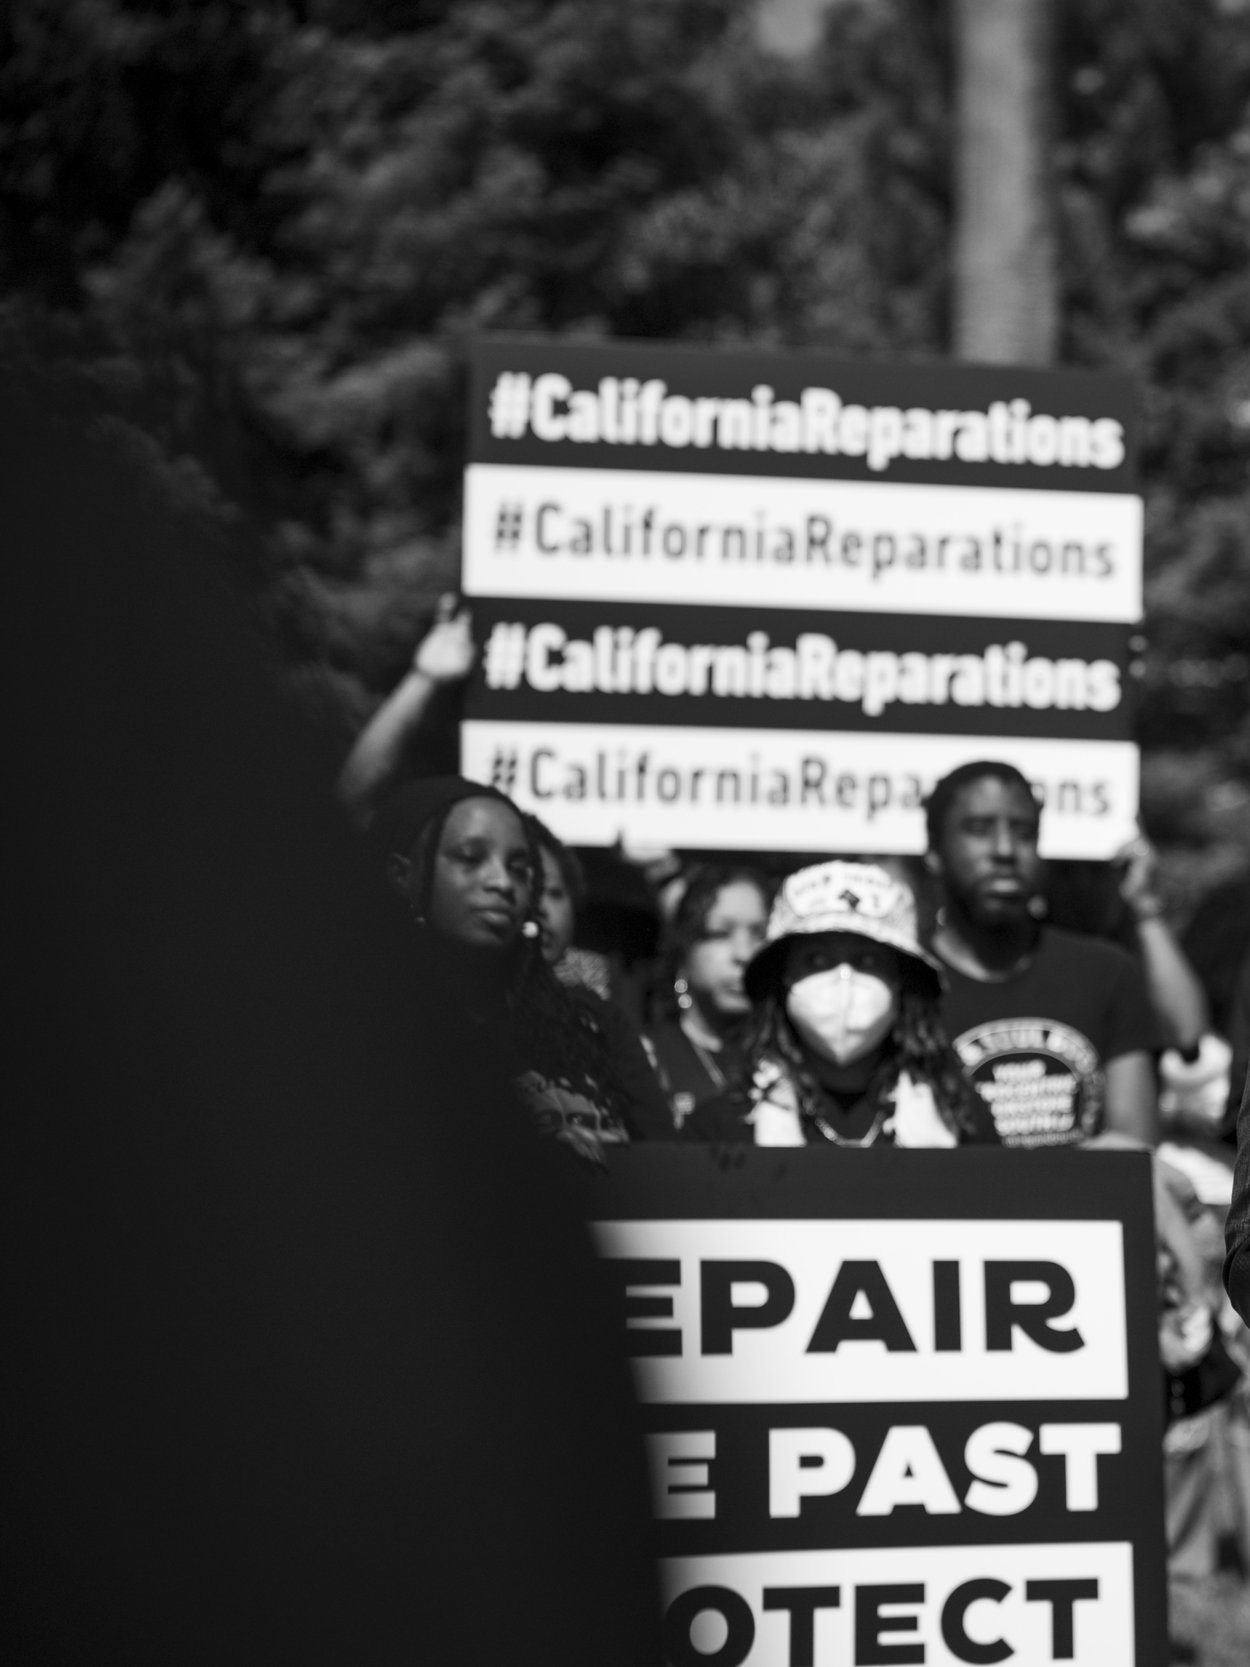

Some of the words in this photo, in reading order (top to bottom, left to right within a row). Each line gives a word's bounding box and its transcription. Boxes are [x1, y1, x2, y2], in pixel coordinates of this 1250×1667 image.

[489, 372, 1124, 471] #CaliforniaReparations
[494, 500, 1115, 579] #CaliforniaReparations
[484, 622, 1121, 716] #CaliforniaReparations
[491, 747, 1110, 821] #CaliforniaRepaons
[600, 1258, 1085, 1356] EPAIR
[768, 1421, 1121, 1518] PAST
[664, 1577, 1099, 1667] OTECT
